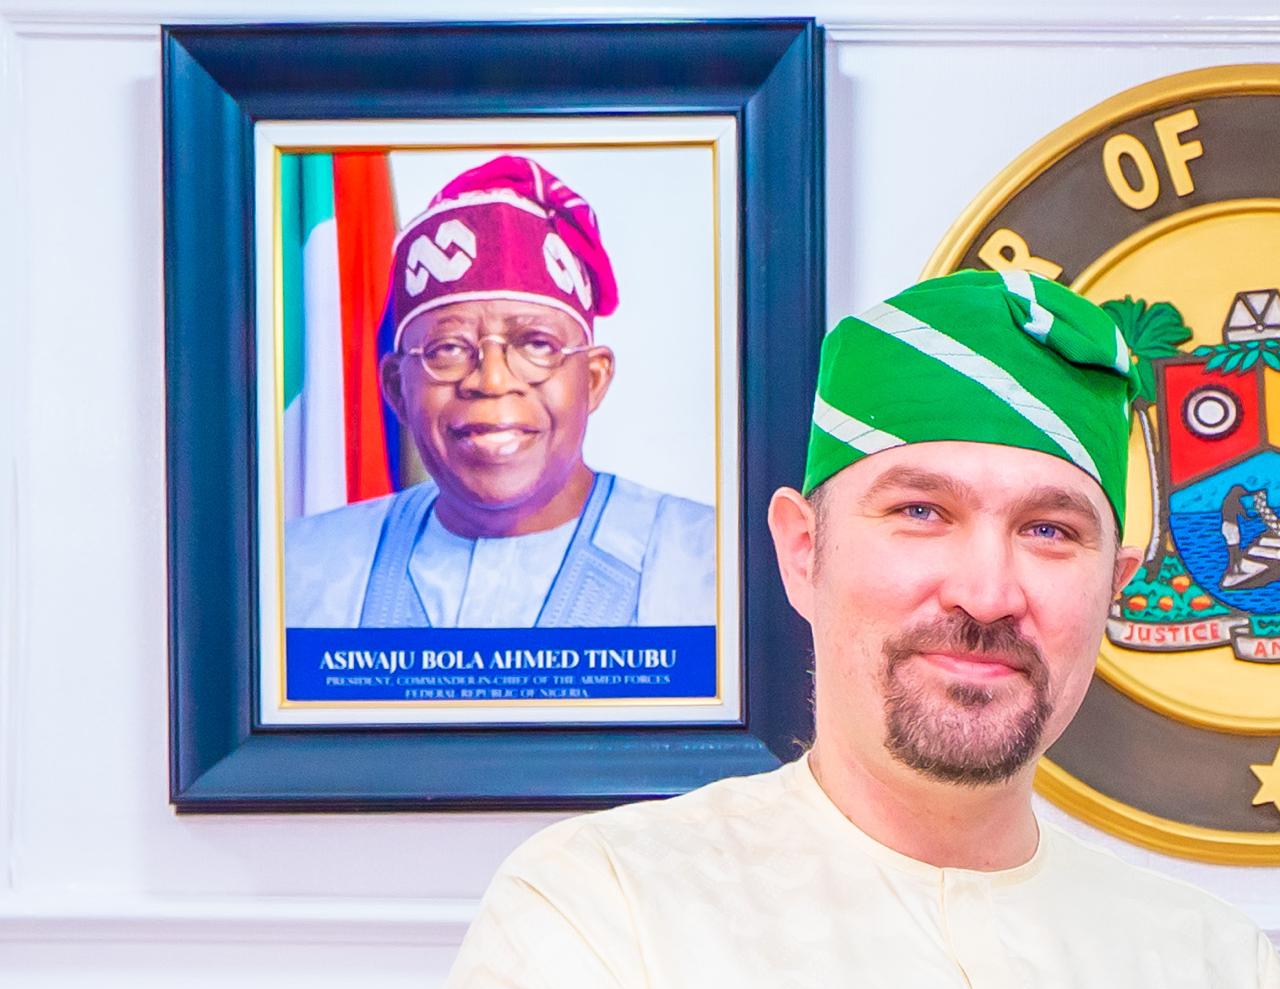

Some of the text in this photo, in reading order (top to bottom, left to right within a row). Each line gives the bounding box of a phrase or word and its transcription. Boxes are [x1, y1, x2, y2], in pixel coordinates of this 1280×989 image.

[1102, 108, 1204, 211] OF
[1123, 621, 1222, 643] JUSTICE
[319, 648, 677, 674] ASIWAJU BOLA AHMED TINUBU
[624, 674, 671, 685] FORCES
